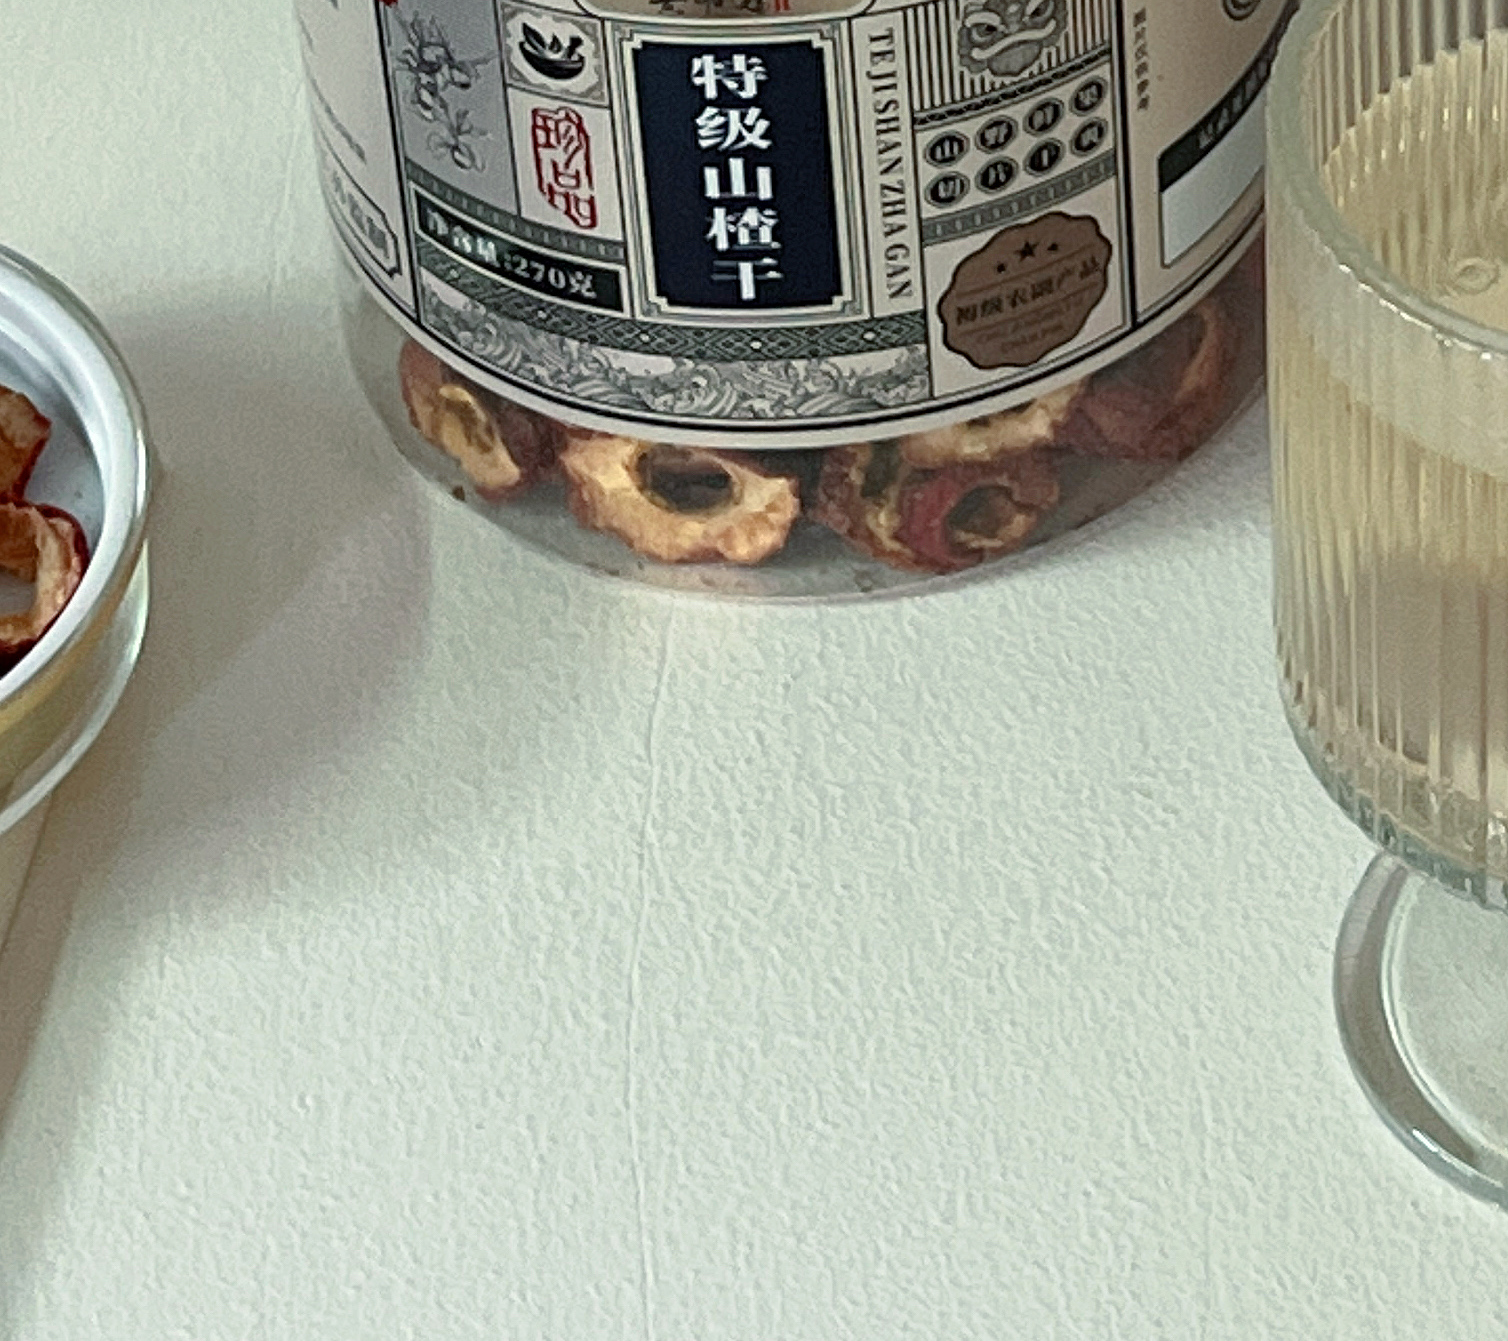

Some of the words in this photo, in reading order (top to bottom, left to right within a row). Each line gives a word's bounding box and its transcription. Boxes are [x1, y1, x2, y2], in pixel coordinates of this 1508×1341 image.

[690, 53, 785, 301] 特级山楂干
[880, 181, 907, 238] ZHA
[884, 246, 913, 300] GAN
